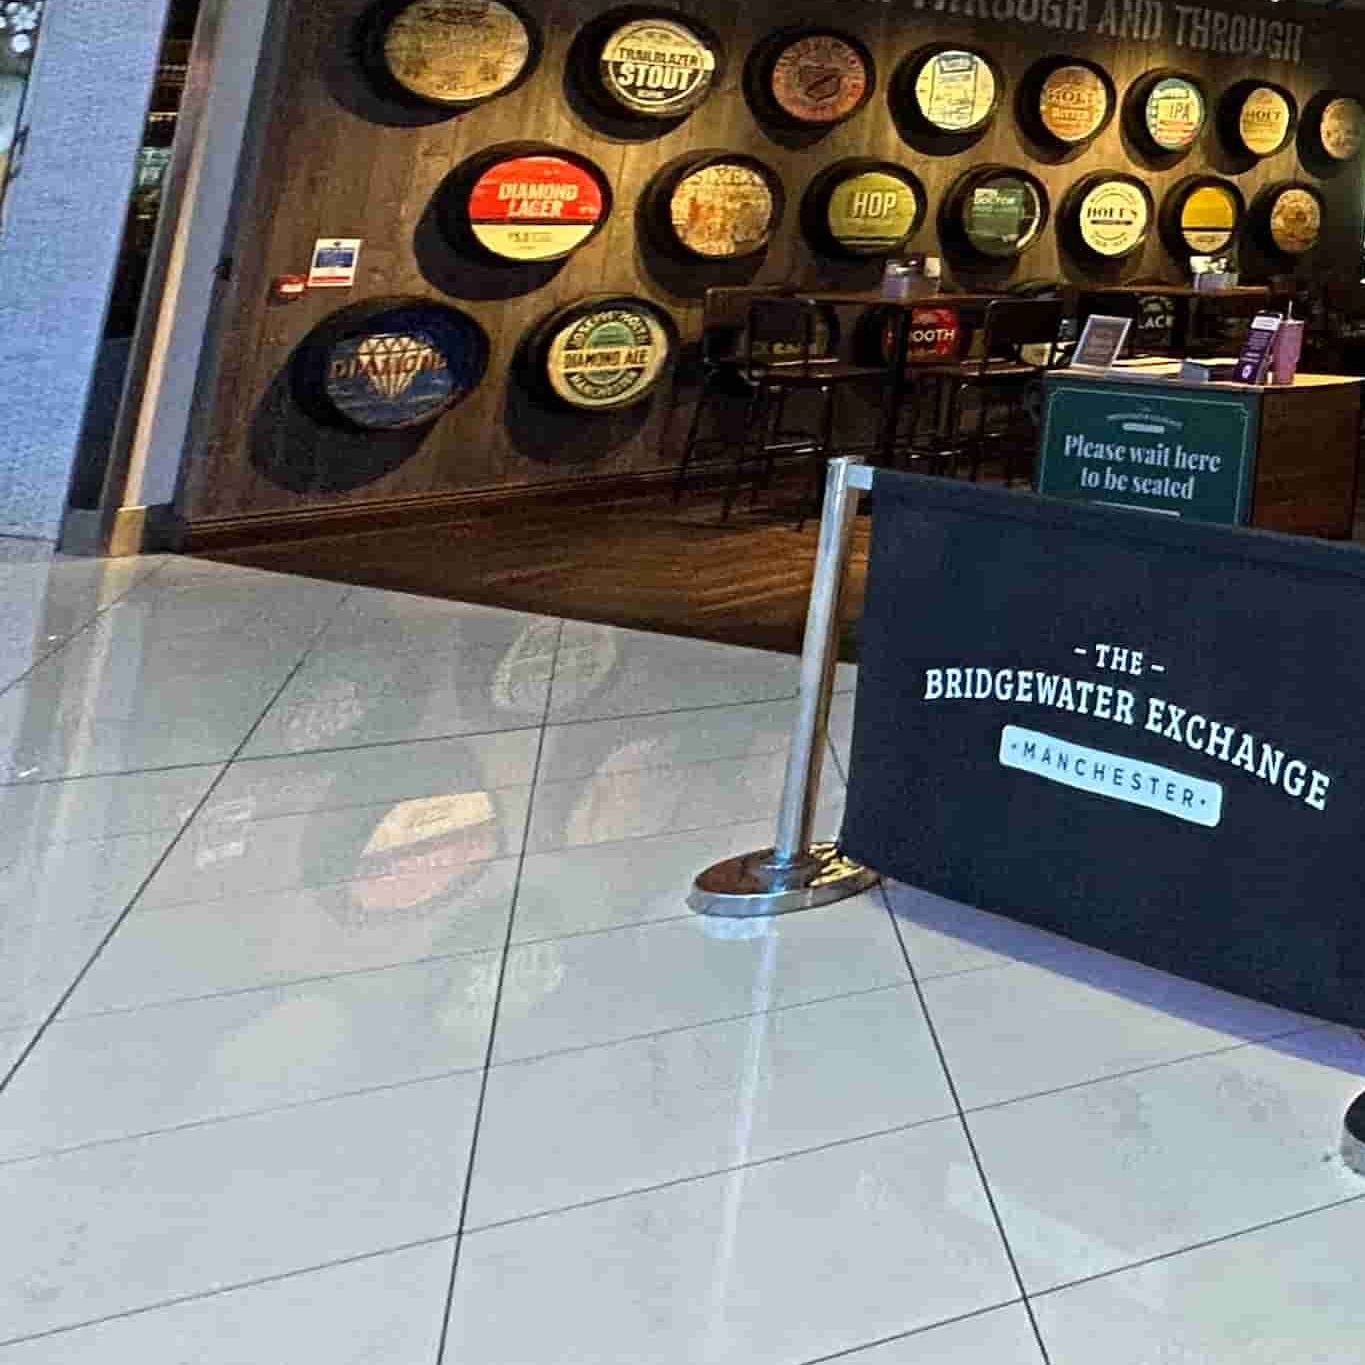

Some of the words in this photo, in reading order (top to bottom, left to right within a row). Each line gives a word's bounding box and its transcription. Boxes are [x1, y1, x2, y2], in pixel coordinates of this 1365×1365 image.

[1175, 4, 1303, 64] THROUGH
[619, 47, 699, 66] TRAILBLAZER
[617, 63, 694, 91] STOUT
[1168, 100, 1190, 121] IPA
[498, 182, 579, 201] DIAMOND
[853, 190, 897, 219] HOP
[507, 200, 564, 218] LAGER
[564, 350, 621, 369] DIAMOND
[624, 349, 649, 365] ALE
[1063, 433, 1126, 463] Please
[1129, 443, 1170, 467] wait
[1174, 445, 1222, 473] here
[1080, 466, 1100, 488] to
[1104, 466, 1128, 491] be
[1133, 475, 1196, 500] seated
[1095, 642, 1143, 677] THE
[923, 666, 1136, 725] BRIDGEWATER
[1145, 697, 1331, 811] EXCHANGE
[1022, 740, 1196, 809] MANCHESTER
